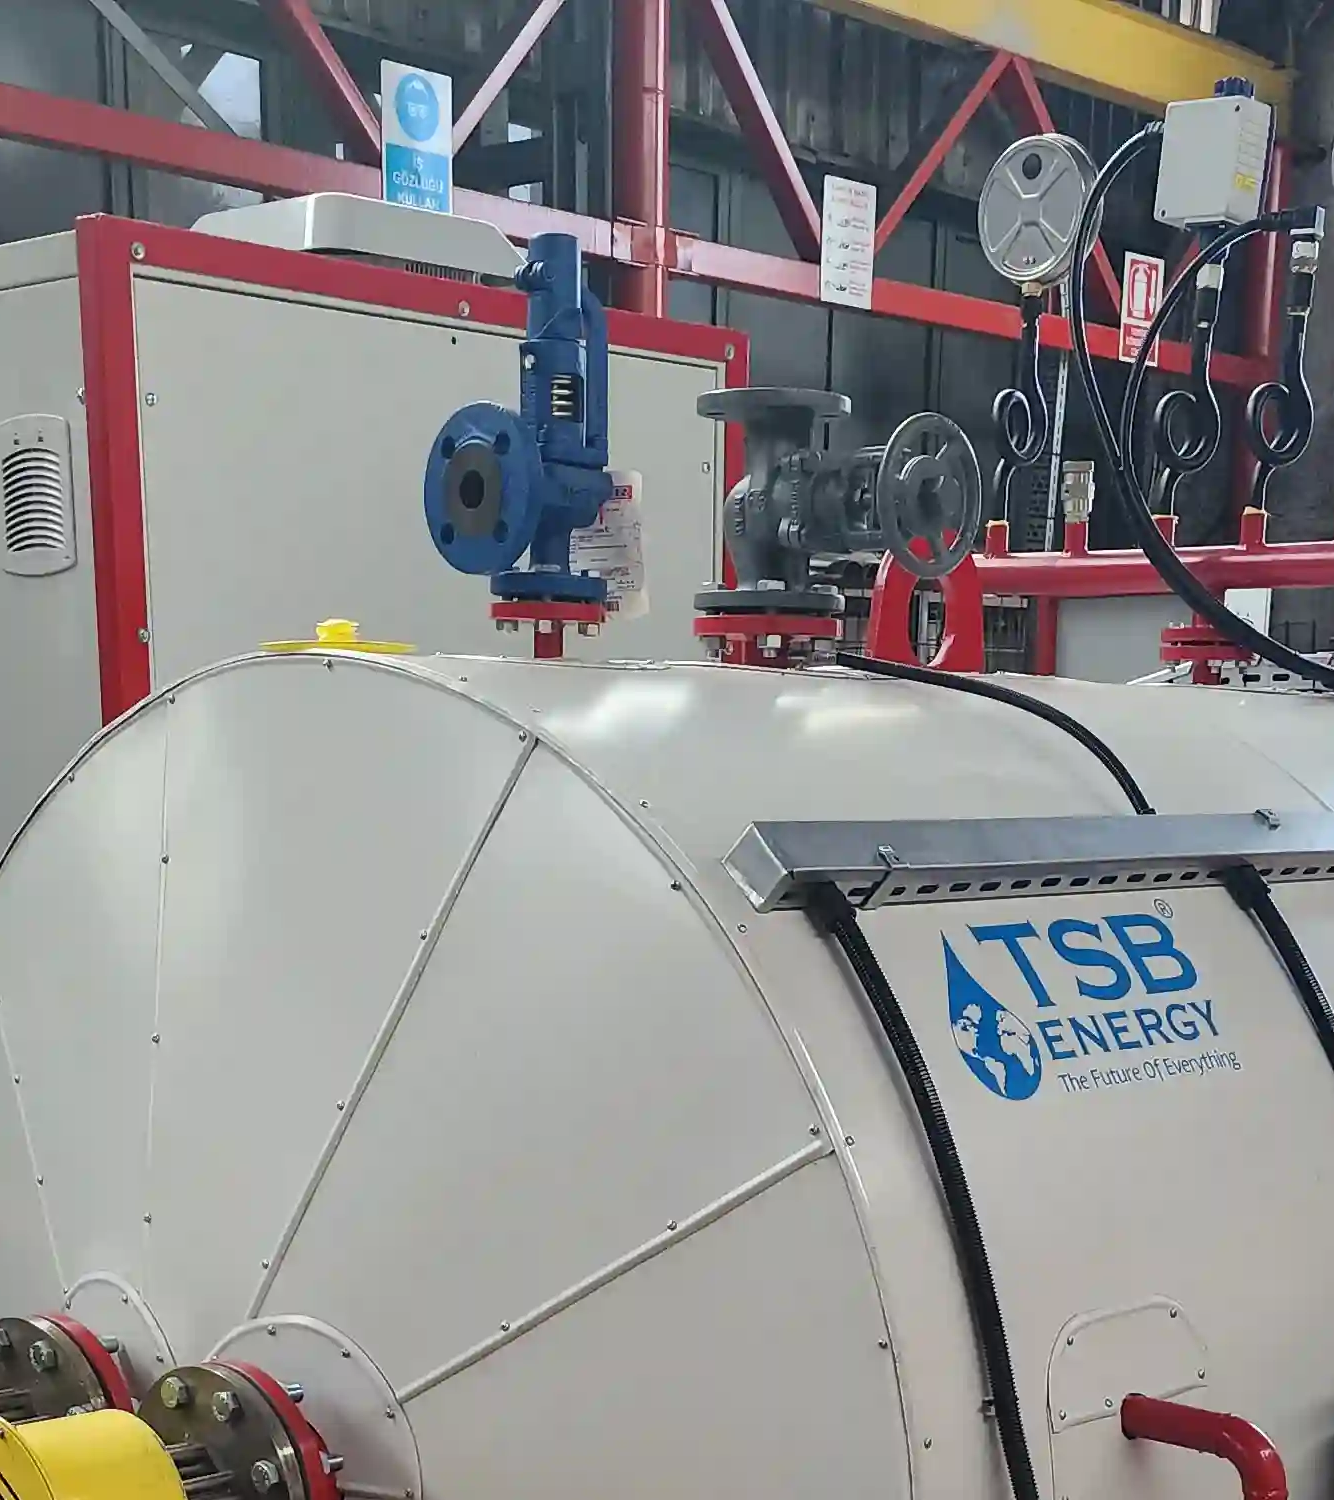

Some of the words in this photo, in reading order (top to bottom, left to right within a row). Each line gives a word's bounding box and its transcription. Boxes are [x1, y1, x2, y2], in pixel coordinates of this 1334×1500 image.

[966, 913, 1198, 1008] TSB
[1035, 999, 1220, 1061] ENERGY
[1058, 1072, 1089, 1093] The
[1089, 1065, 1143, 1089] Future
[1142, 1057, 1164, 1083] Of
[1165, 1048, 1242, 1077] Everything
